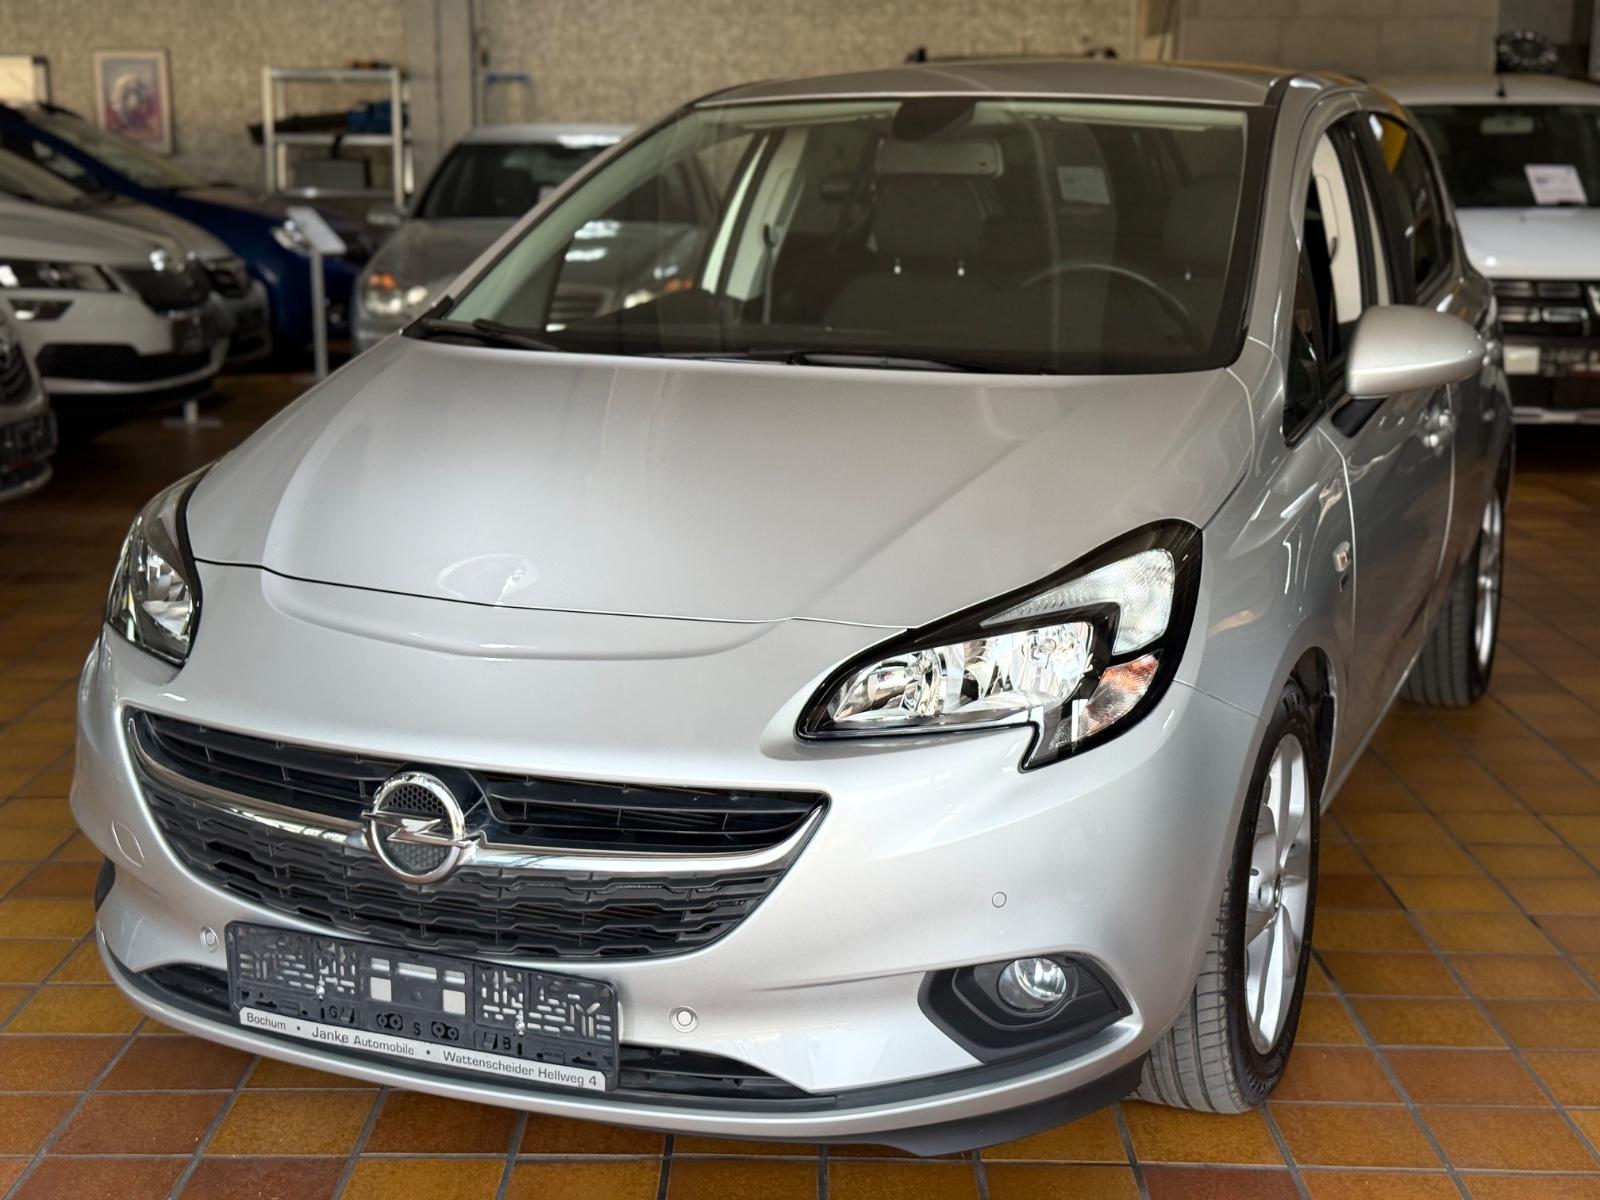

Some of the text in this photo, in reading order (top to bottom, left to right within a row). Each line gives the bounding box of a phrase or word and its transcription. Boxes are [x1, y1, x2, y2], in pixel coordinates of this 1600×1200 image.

[246, 1012, 597, 1087] Bochum Janke Automobile Wattenscheider Hellweg 4
